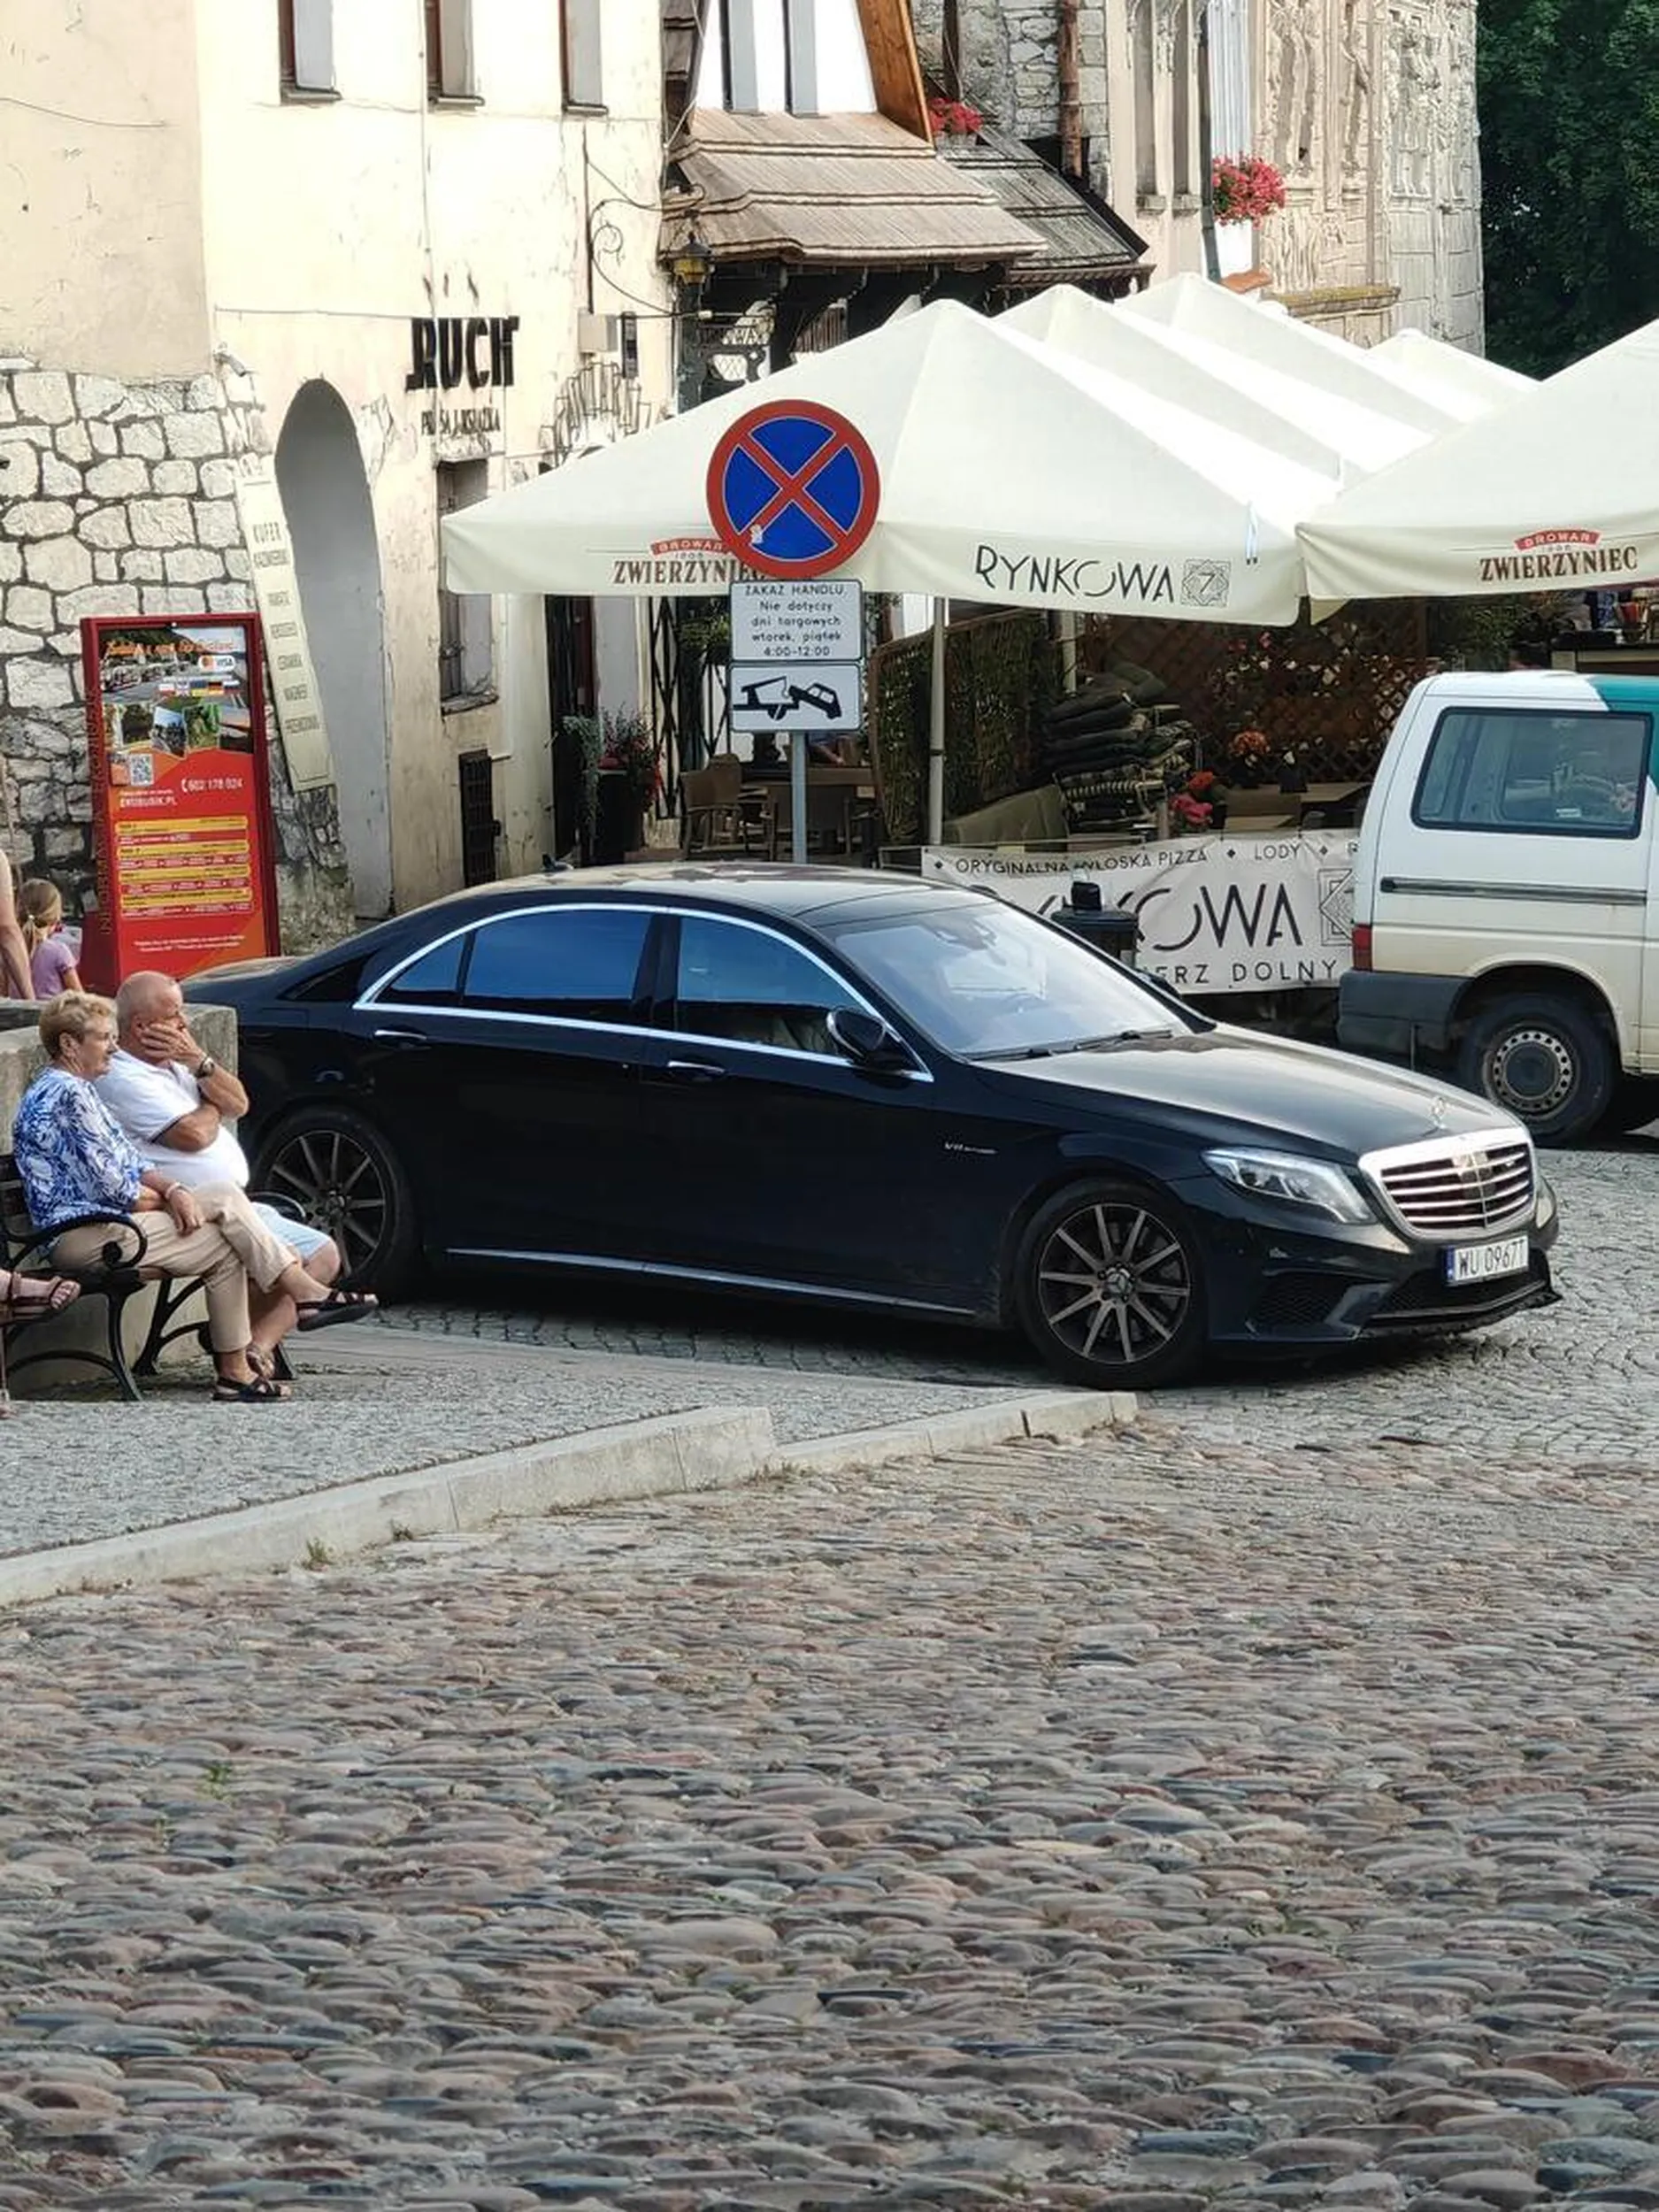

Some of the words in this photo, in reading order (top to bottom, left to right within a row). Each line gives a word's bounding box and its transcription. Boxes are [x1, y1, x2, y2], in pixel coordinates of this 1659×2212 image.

[405, 316, 519, 391] RUCH
[976, 545, 1173, 603] RYNKOWA
[1480, 546, 1638, 582] ZWIERZYNIEC
[745, 585, 784, 595] ZAKAZ
[761, 602, 780, 611] Nie
[787, 602, 833, 612] dotyczy
[751, 617, 771, 626] dni
[779, 617, 841, 628] targowych
[764, 646, 830, 657] 4:00-12:00
[956, 858, 1069, 873] ORYGINALNA
[1158, 849, 1207, 865] PIZZA
[1256, 843, 1301, 861] LODY
[1233, 960, 1336, 982] DOLNY
[1458, 1248, 1479, 1276] WU
